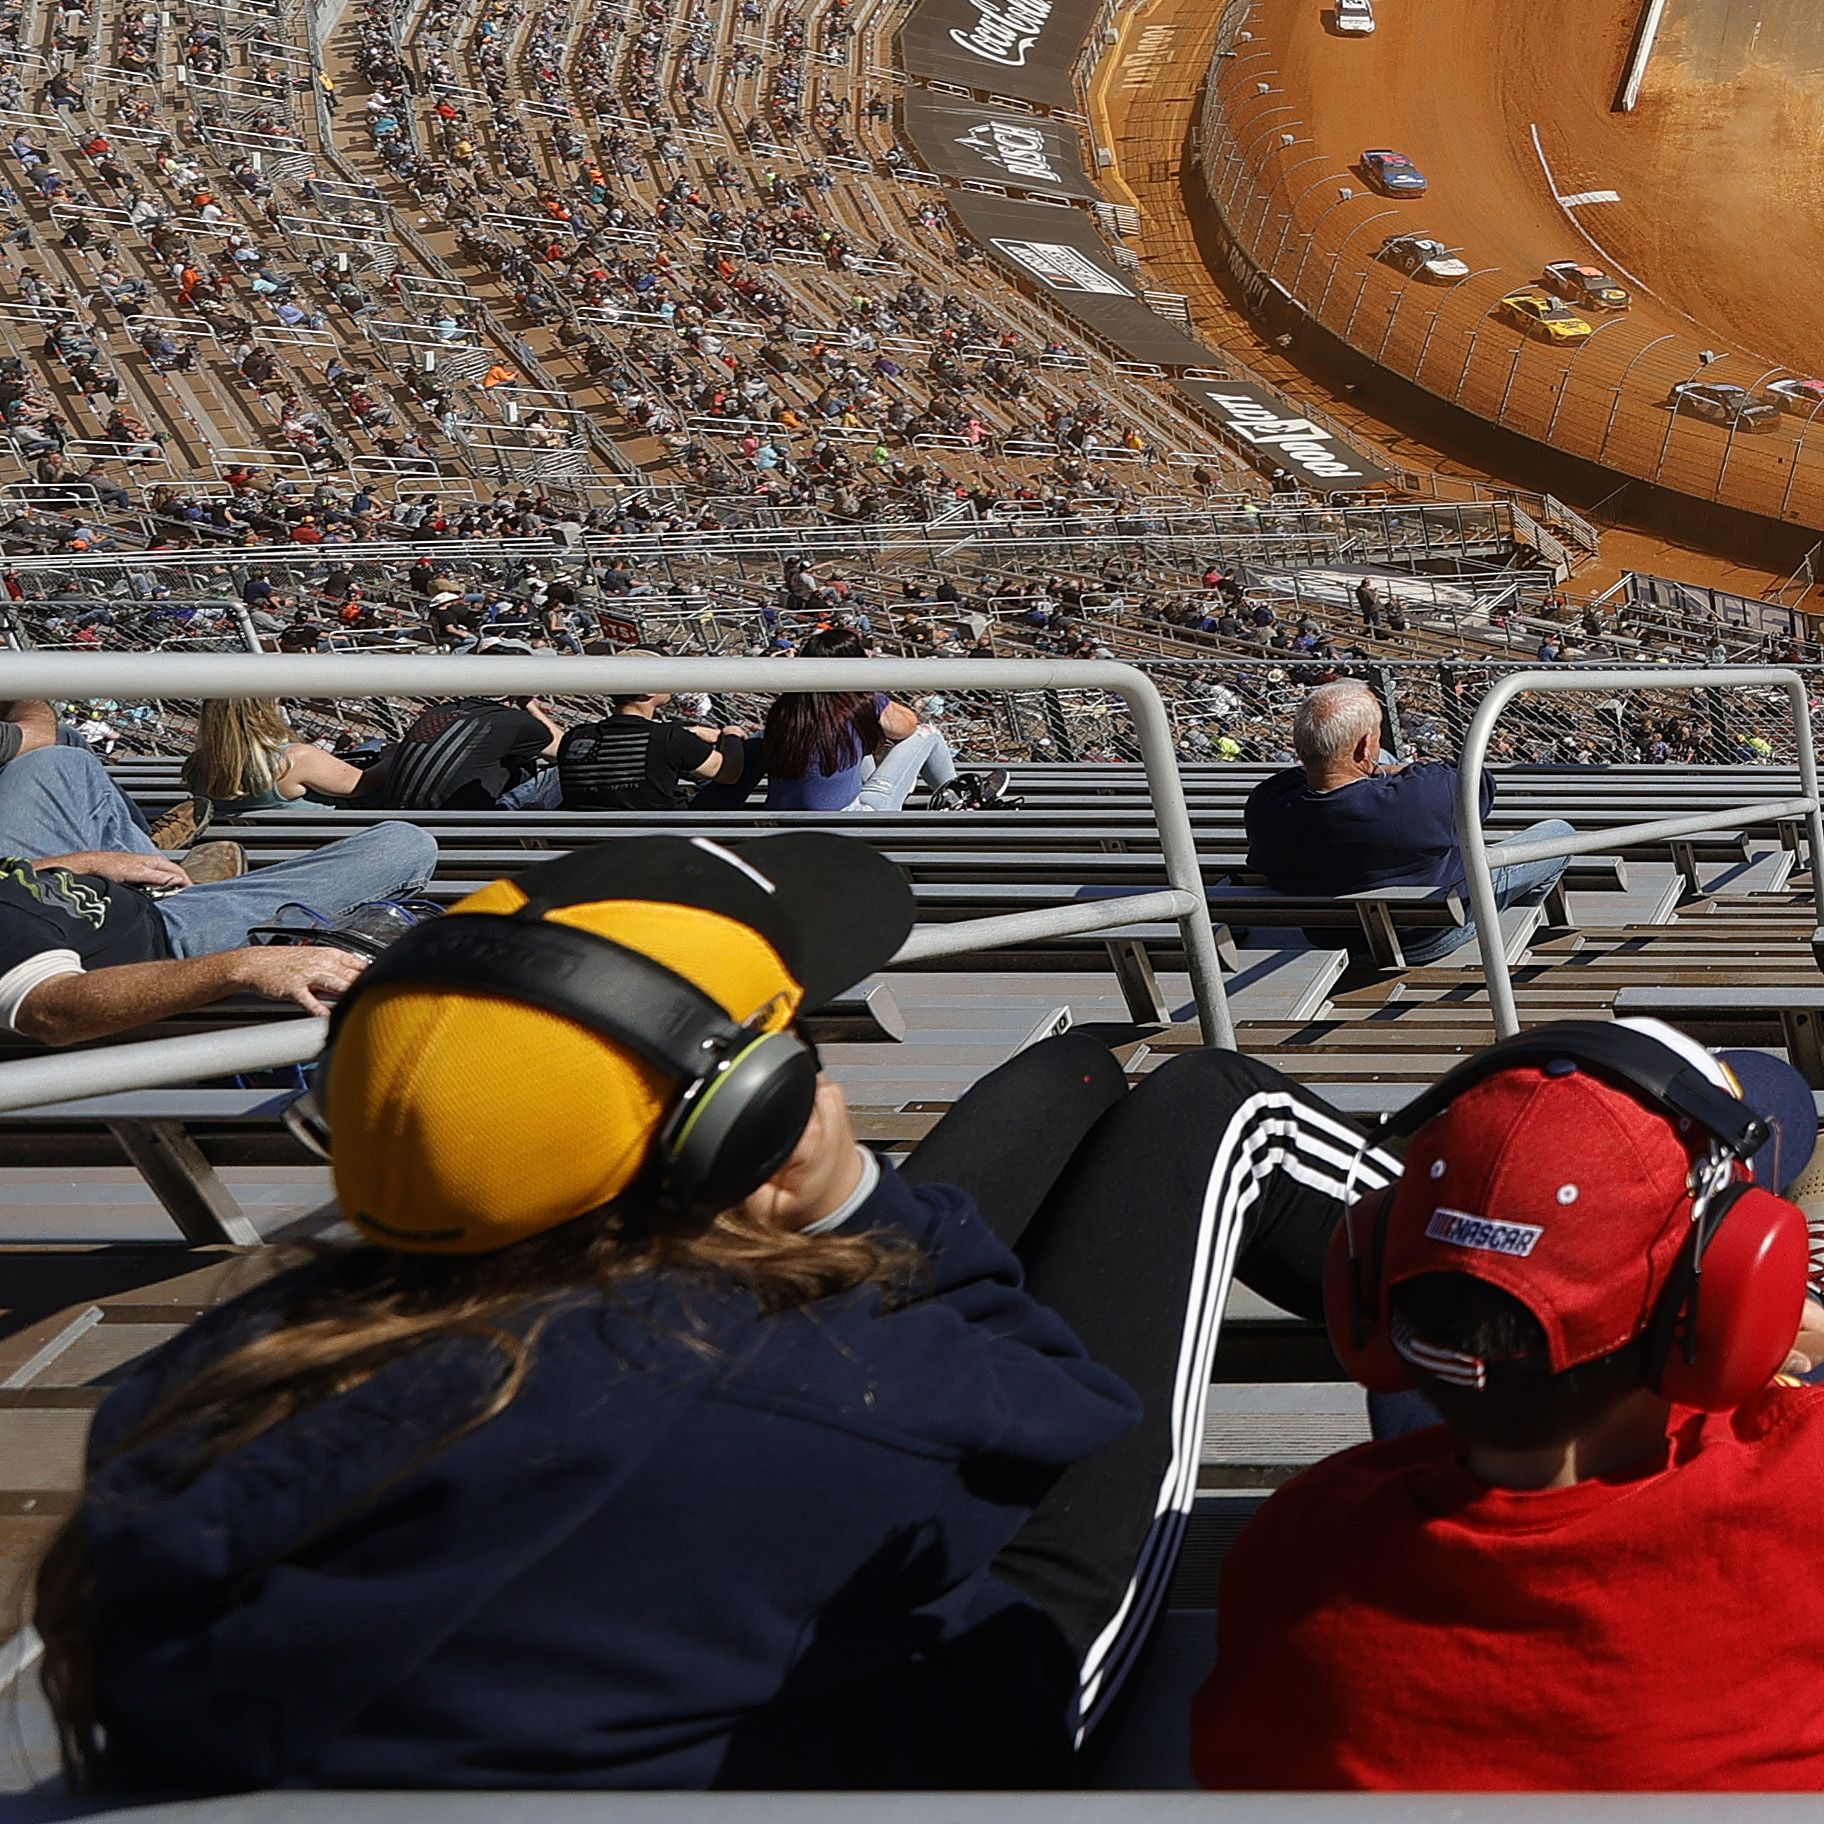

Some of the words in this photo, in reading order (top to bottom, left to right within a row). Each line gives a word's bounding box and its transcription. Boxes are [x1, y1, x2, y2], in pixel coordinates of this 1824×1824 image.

[1206, 391, 1279, 420] CITY
[1279, 441, 1364, 478] FOOD
[1452, 1217, 1535, 1252] NASCAR
